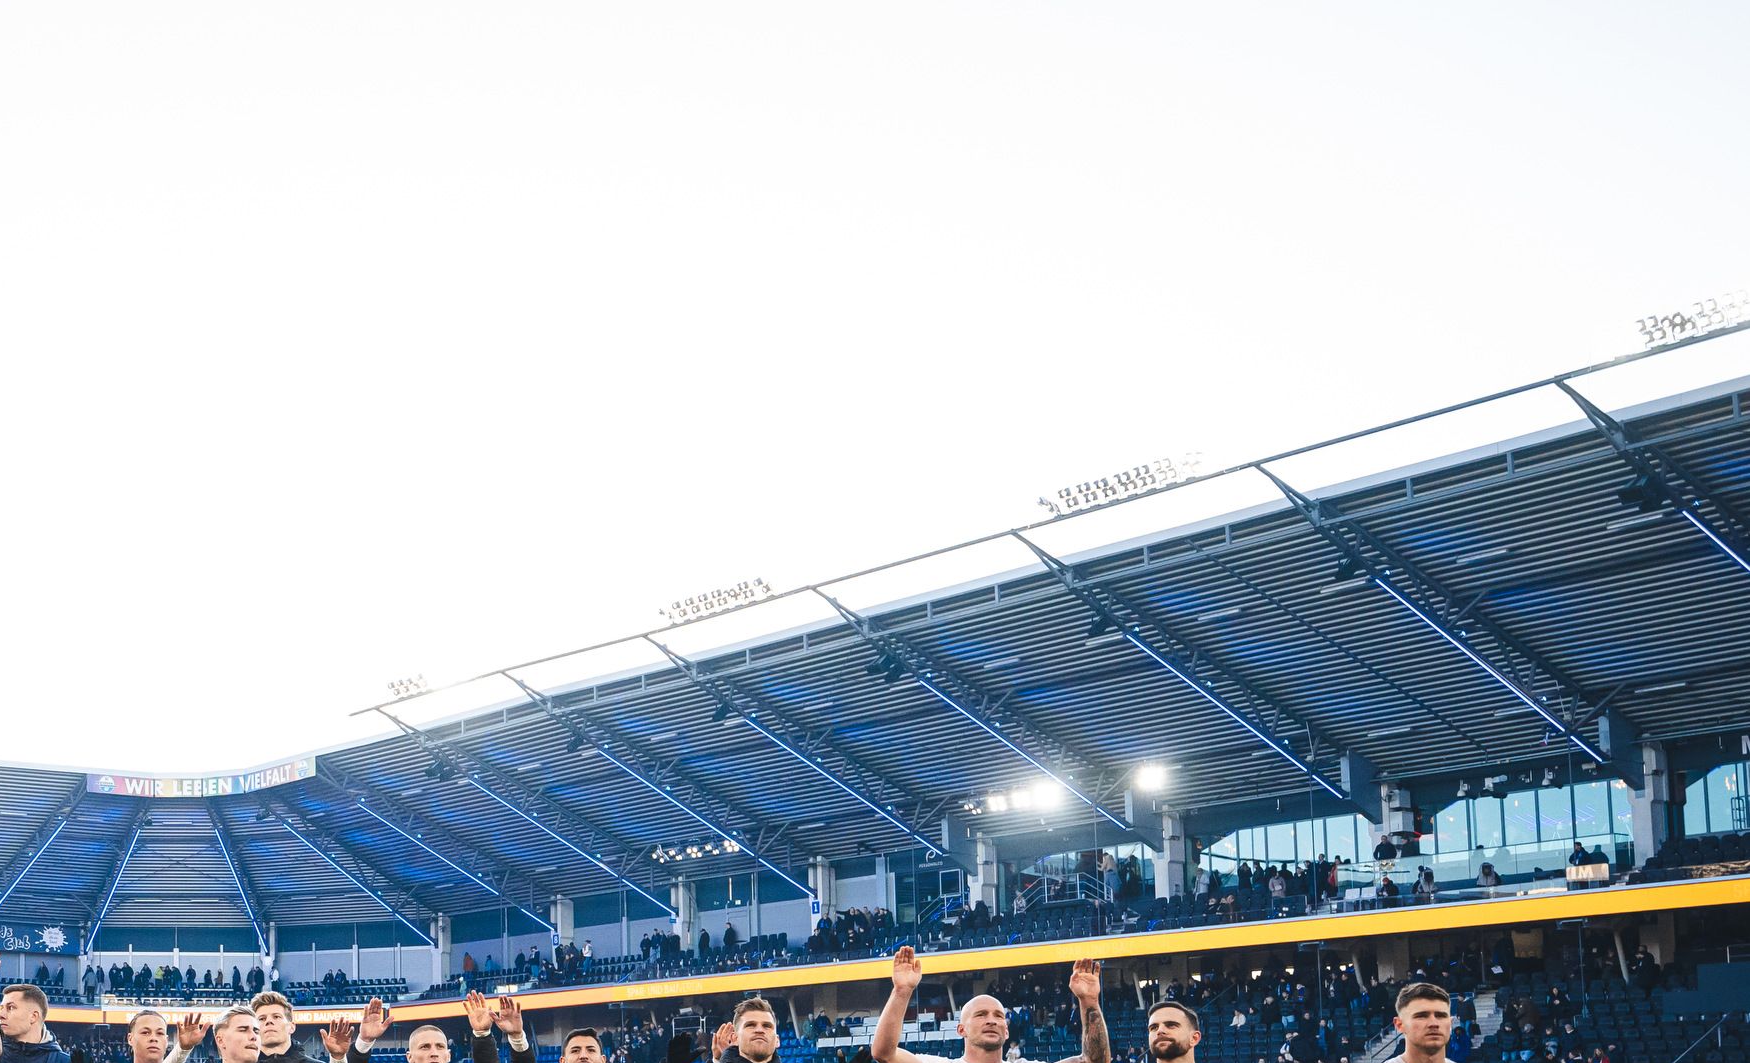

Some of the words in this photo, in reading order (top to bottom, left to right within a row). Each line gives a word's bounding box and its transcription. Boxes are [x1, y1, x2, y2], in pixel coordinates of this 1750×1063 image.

[125, 777, 164, 796] WIR
[172, 778, 233, 797] LEBEN
[239, 765, 291, 792] VIELFALT
[3, 935, 31, 950] Club
